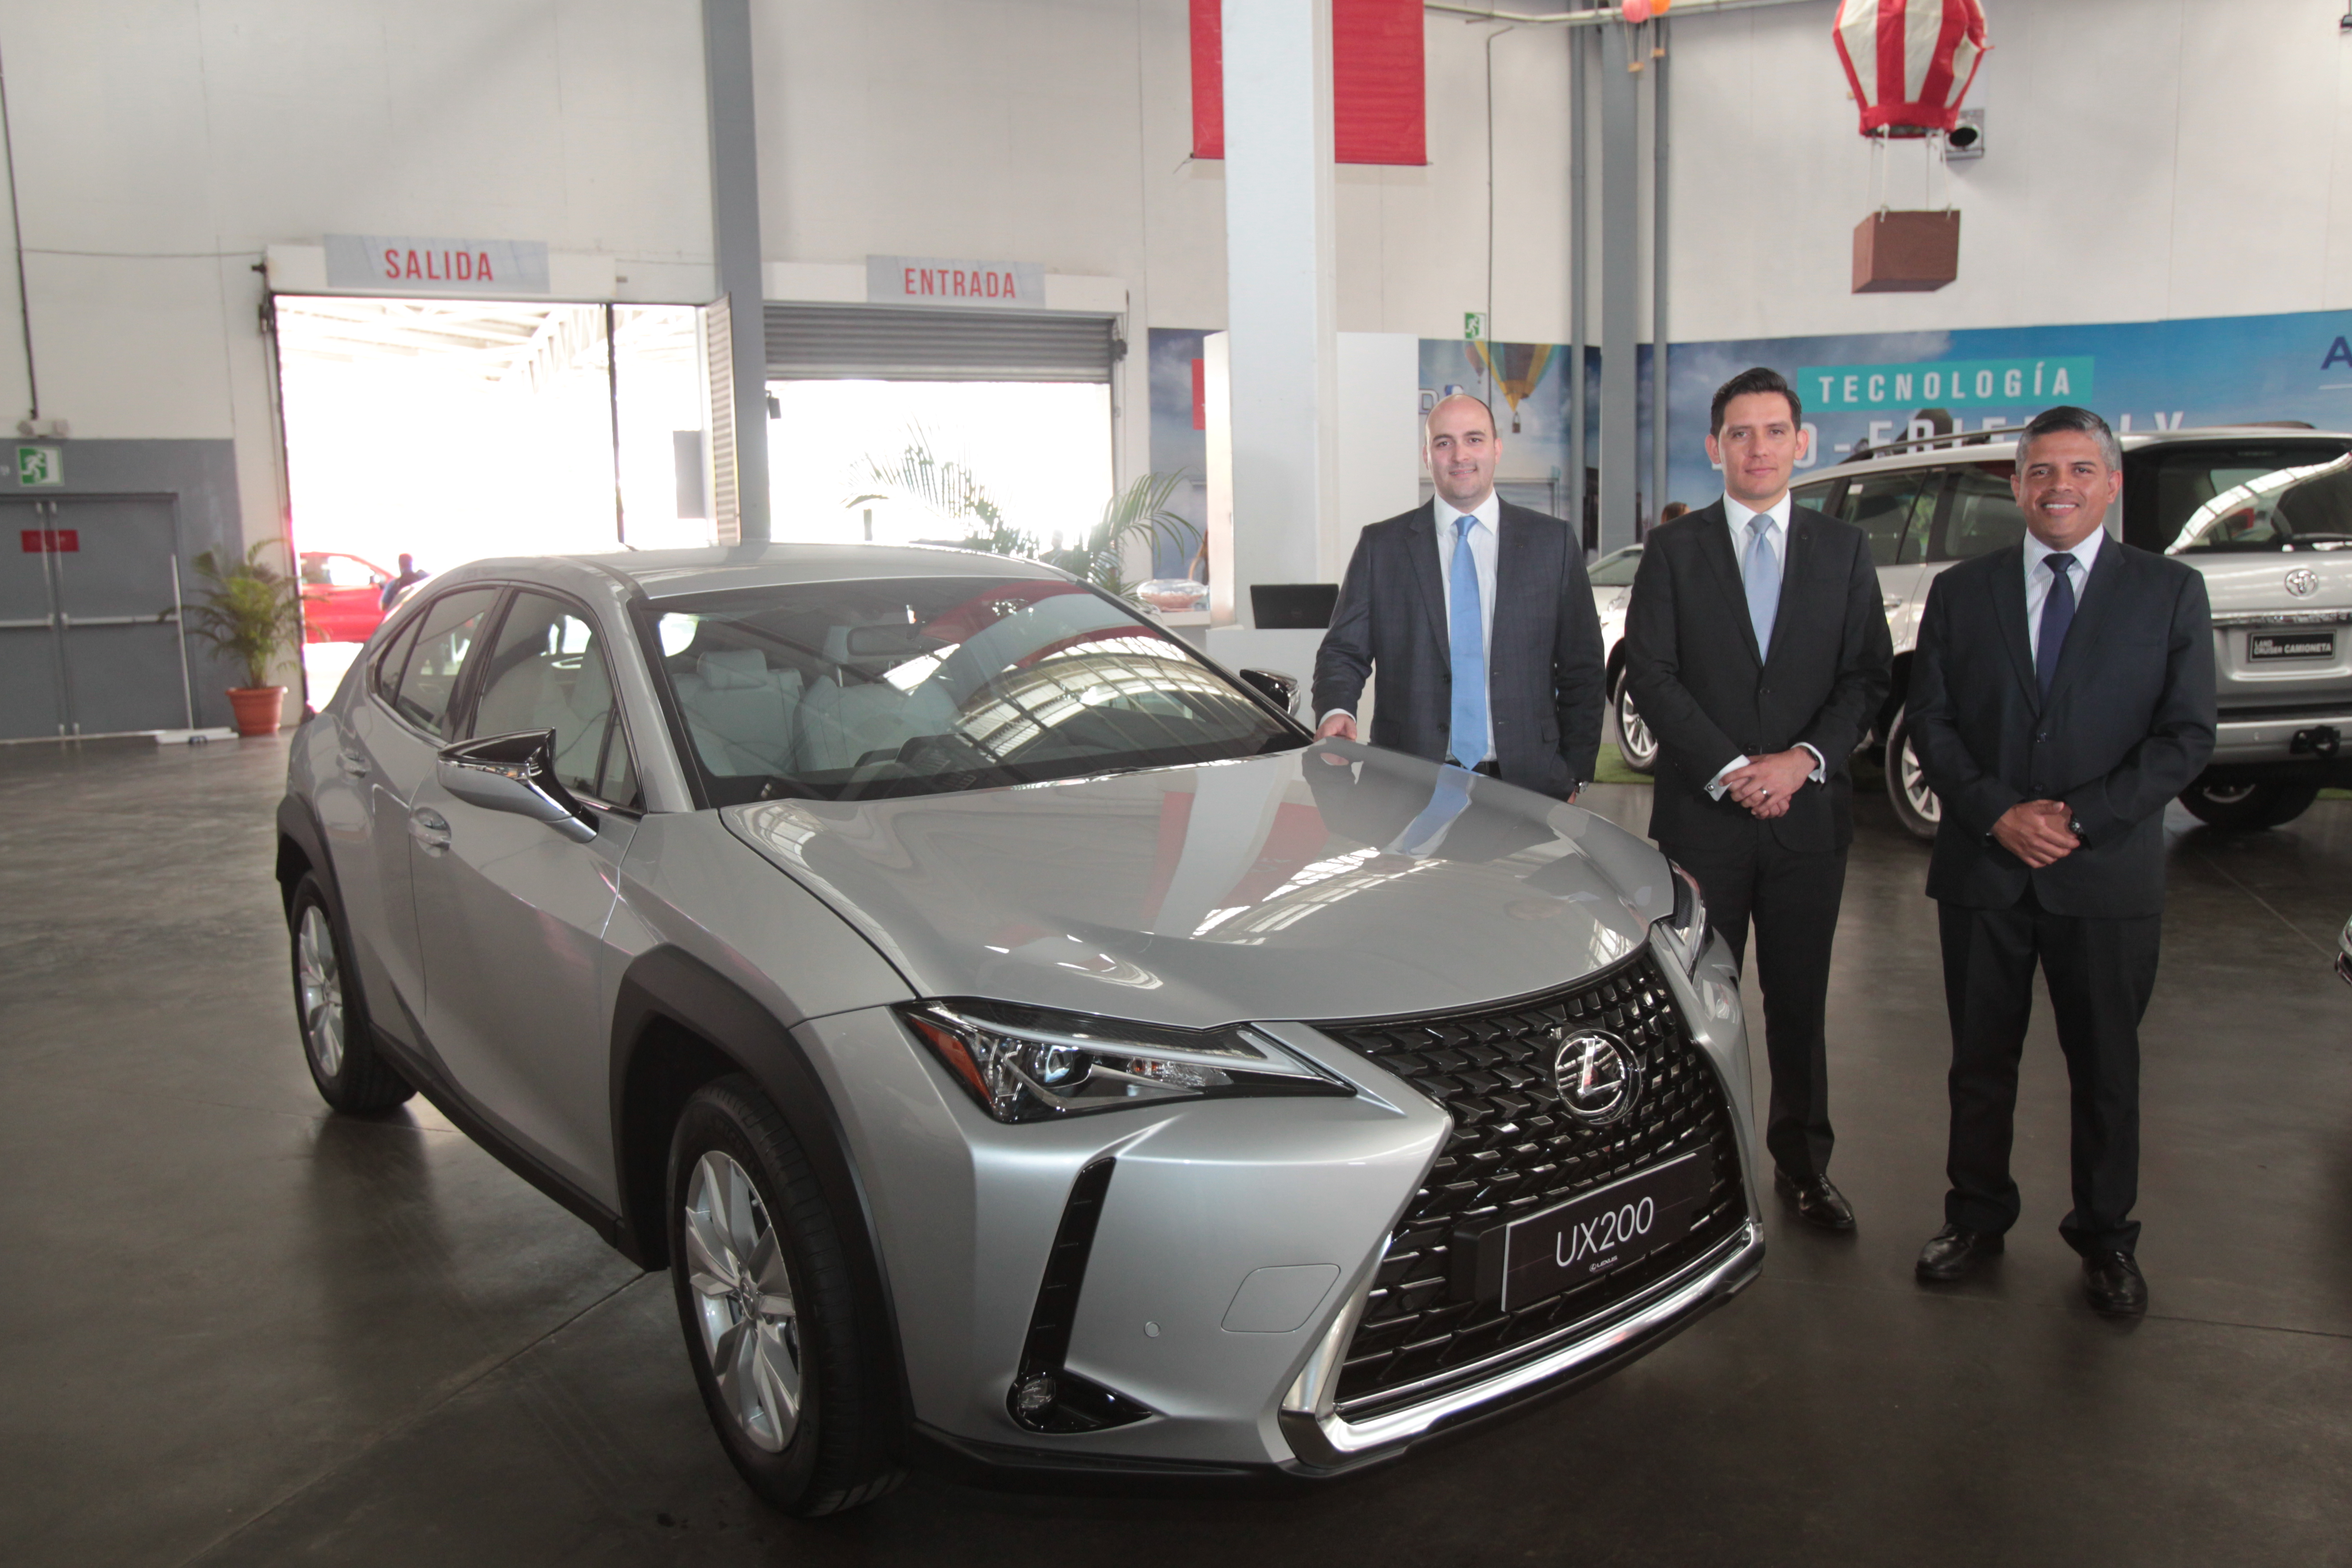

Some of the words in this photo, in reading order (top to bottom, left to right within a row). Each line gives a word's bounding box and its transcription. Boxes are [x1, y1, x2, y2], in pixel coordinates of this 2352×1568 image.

[385, 249, 493, 281] SALIDA
[904, 267, 1017, 299] ENTRADA
[1819, 361, 2070, 404] TECNOLOGÍA
[2284, 642, 2332, 654] CAMIONETA
[1556, 1196, 1654, 1267] UX200
[1597, 1255, 1617, 1267] LEXUS
